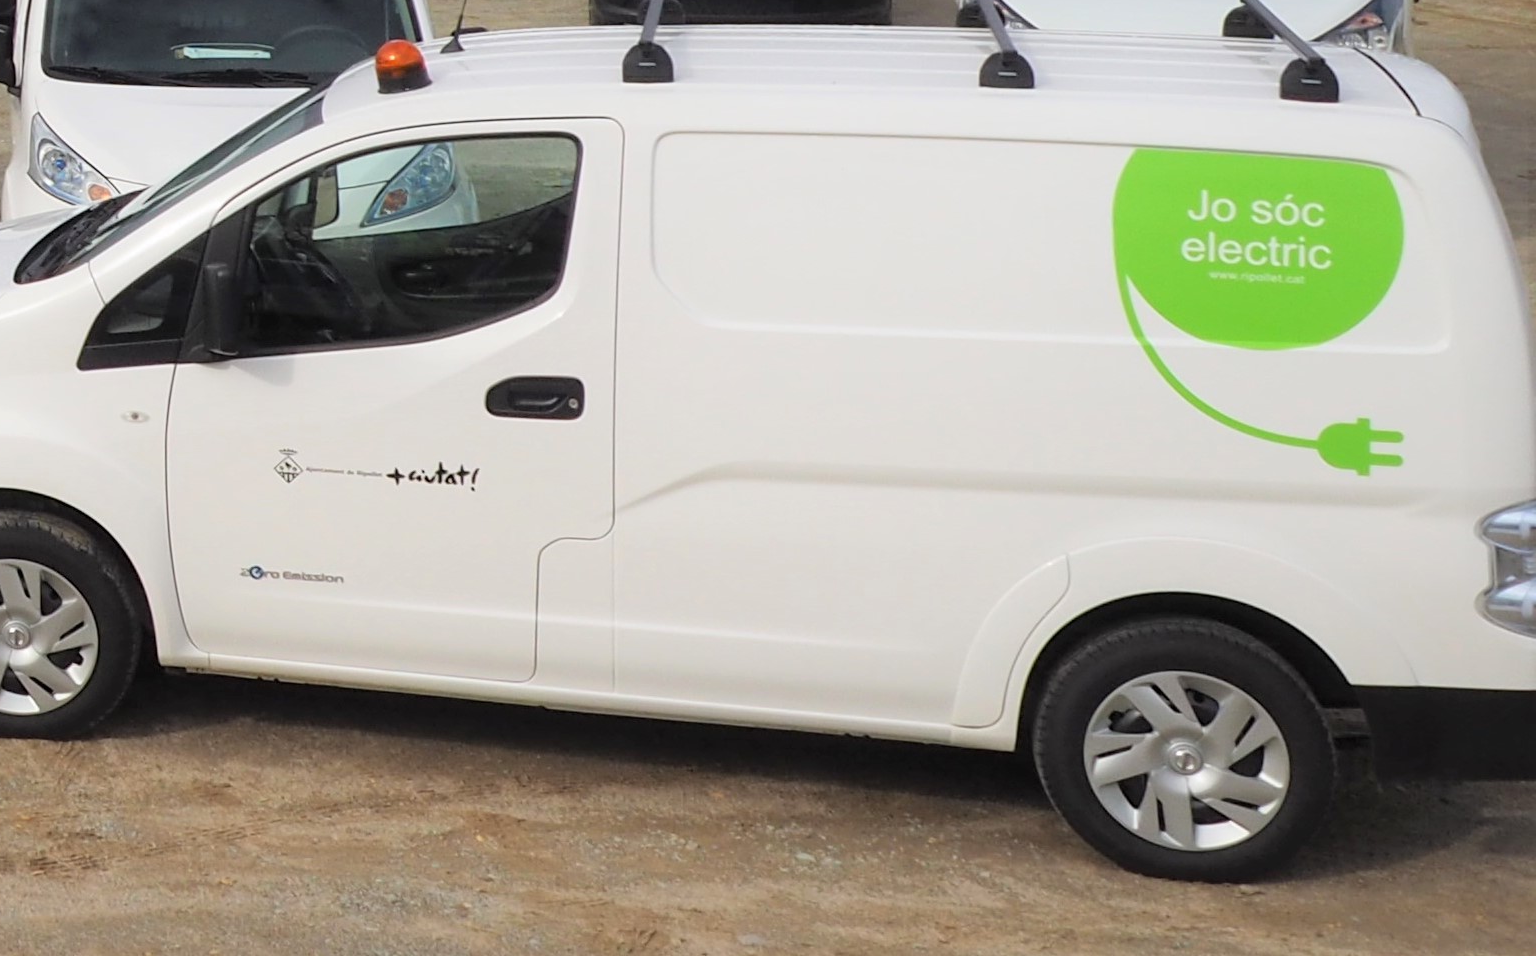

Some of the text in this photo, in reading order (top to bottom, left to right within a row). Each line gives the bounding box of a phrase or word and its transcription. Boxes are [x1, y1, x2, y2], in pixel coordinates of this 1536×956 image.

[1187, 189, 1325, 227] Jo sóc
[1181, 231, 1332, 270] electric
[1208, 271, 1305, 284] www.ripollet.cat
